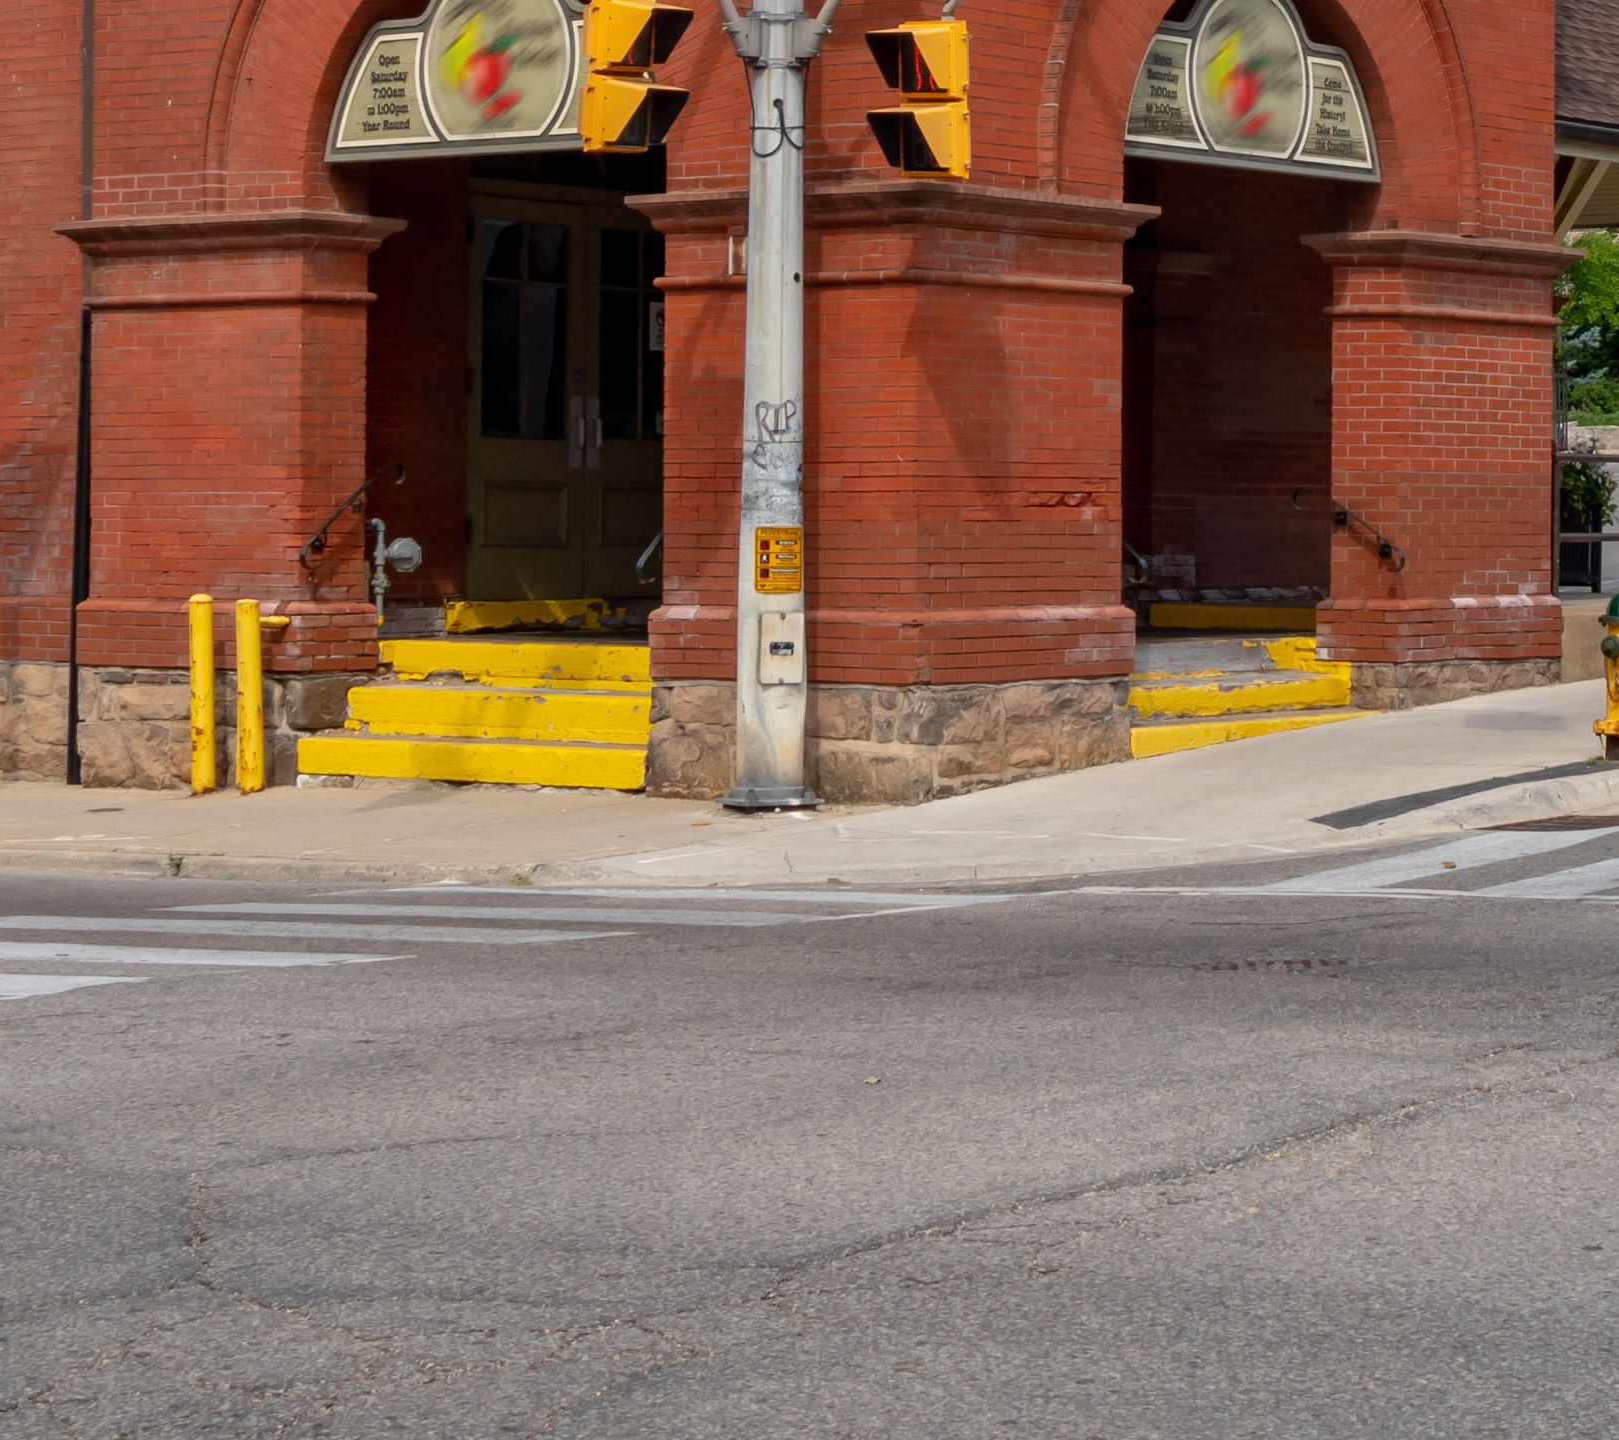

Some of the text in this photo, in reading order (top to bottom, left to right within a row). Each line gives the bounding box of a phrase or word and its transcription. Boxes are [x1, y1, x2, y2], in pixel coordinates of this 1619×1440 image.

[379, 55, 401, 67] Open
[371, 70, 408, 83] Saturday
[1324, 77, 1341, 88] Come
[373, 87, 406, 99] 7:00am
[363, 119, 410, 132] Year Round
[1332, 125, 1350, 137] Home
[755, 400, 797, 442] RIP
